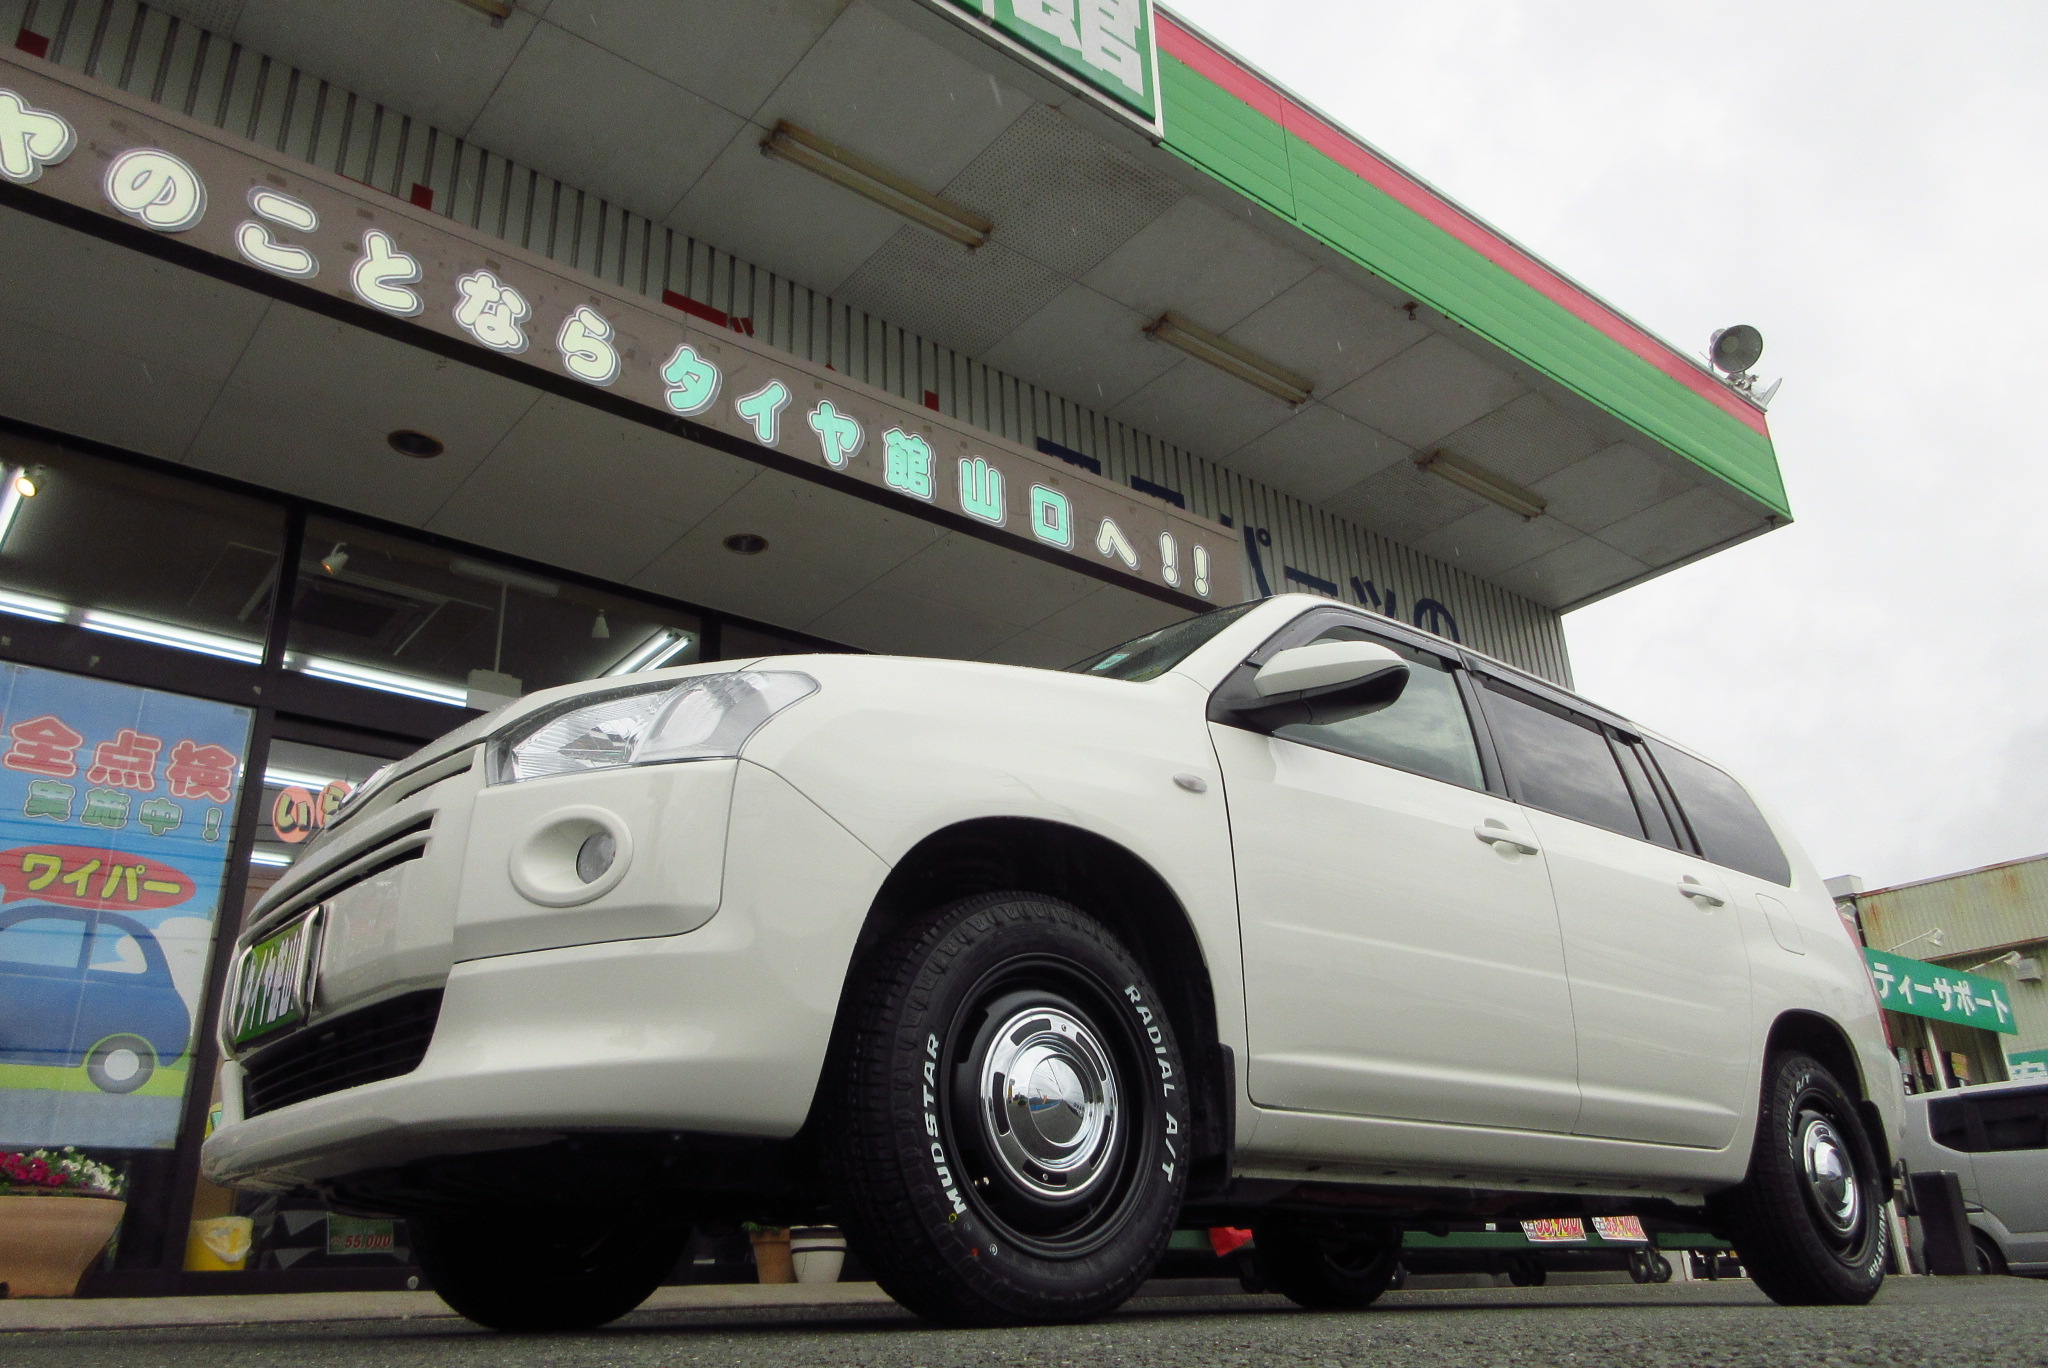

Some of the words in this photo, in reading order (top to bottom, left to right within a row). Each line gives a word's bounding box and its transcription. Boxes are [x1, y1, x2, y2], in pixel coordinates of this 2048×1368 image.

[22, 853, 182, 902] ワイパー
[1873, 962, 2011, 1024] ティーサポート
[1124, 984, 1178, 1098] RADIAL
[1161, 1111, 1179, 1183] A/T
[923, 1032, 968, 1216] MUDSTAR
[1868, 1204, 1886, 1279] MUDSTAR
